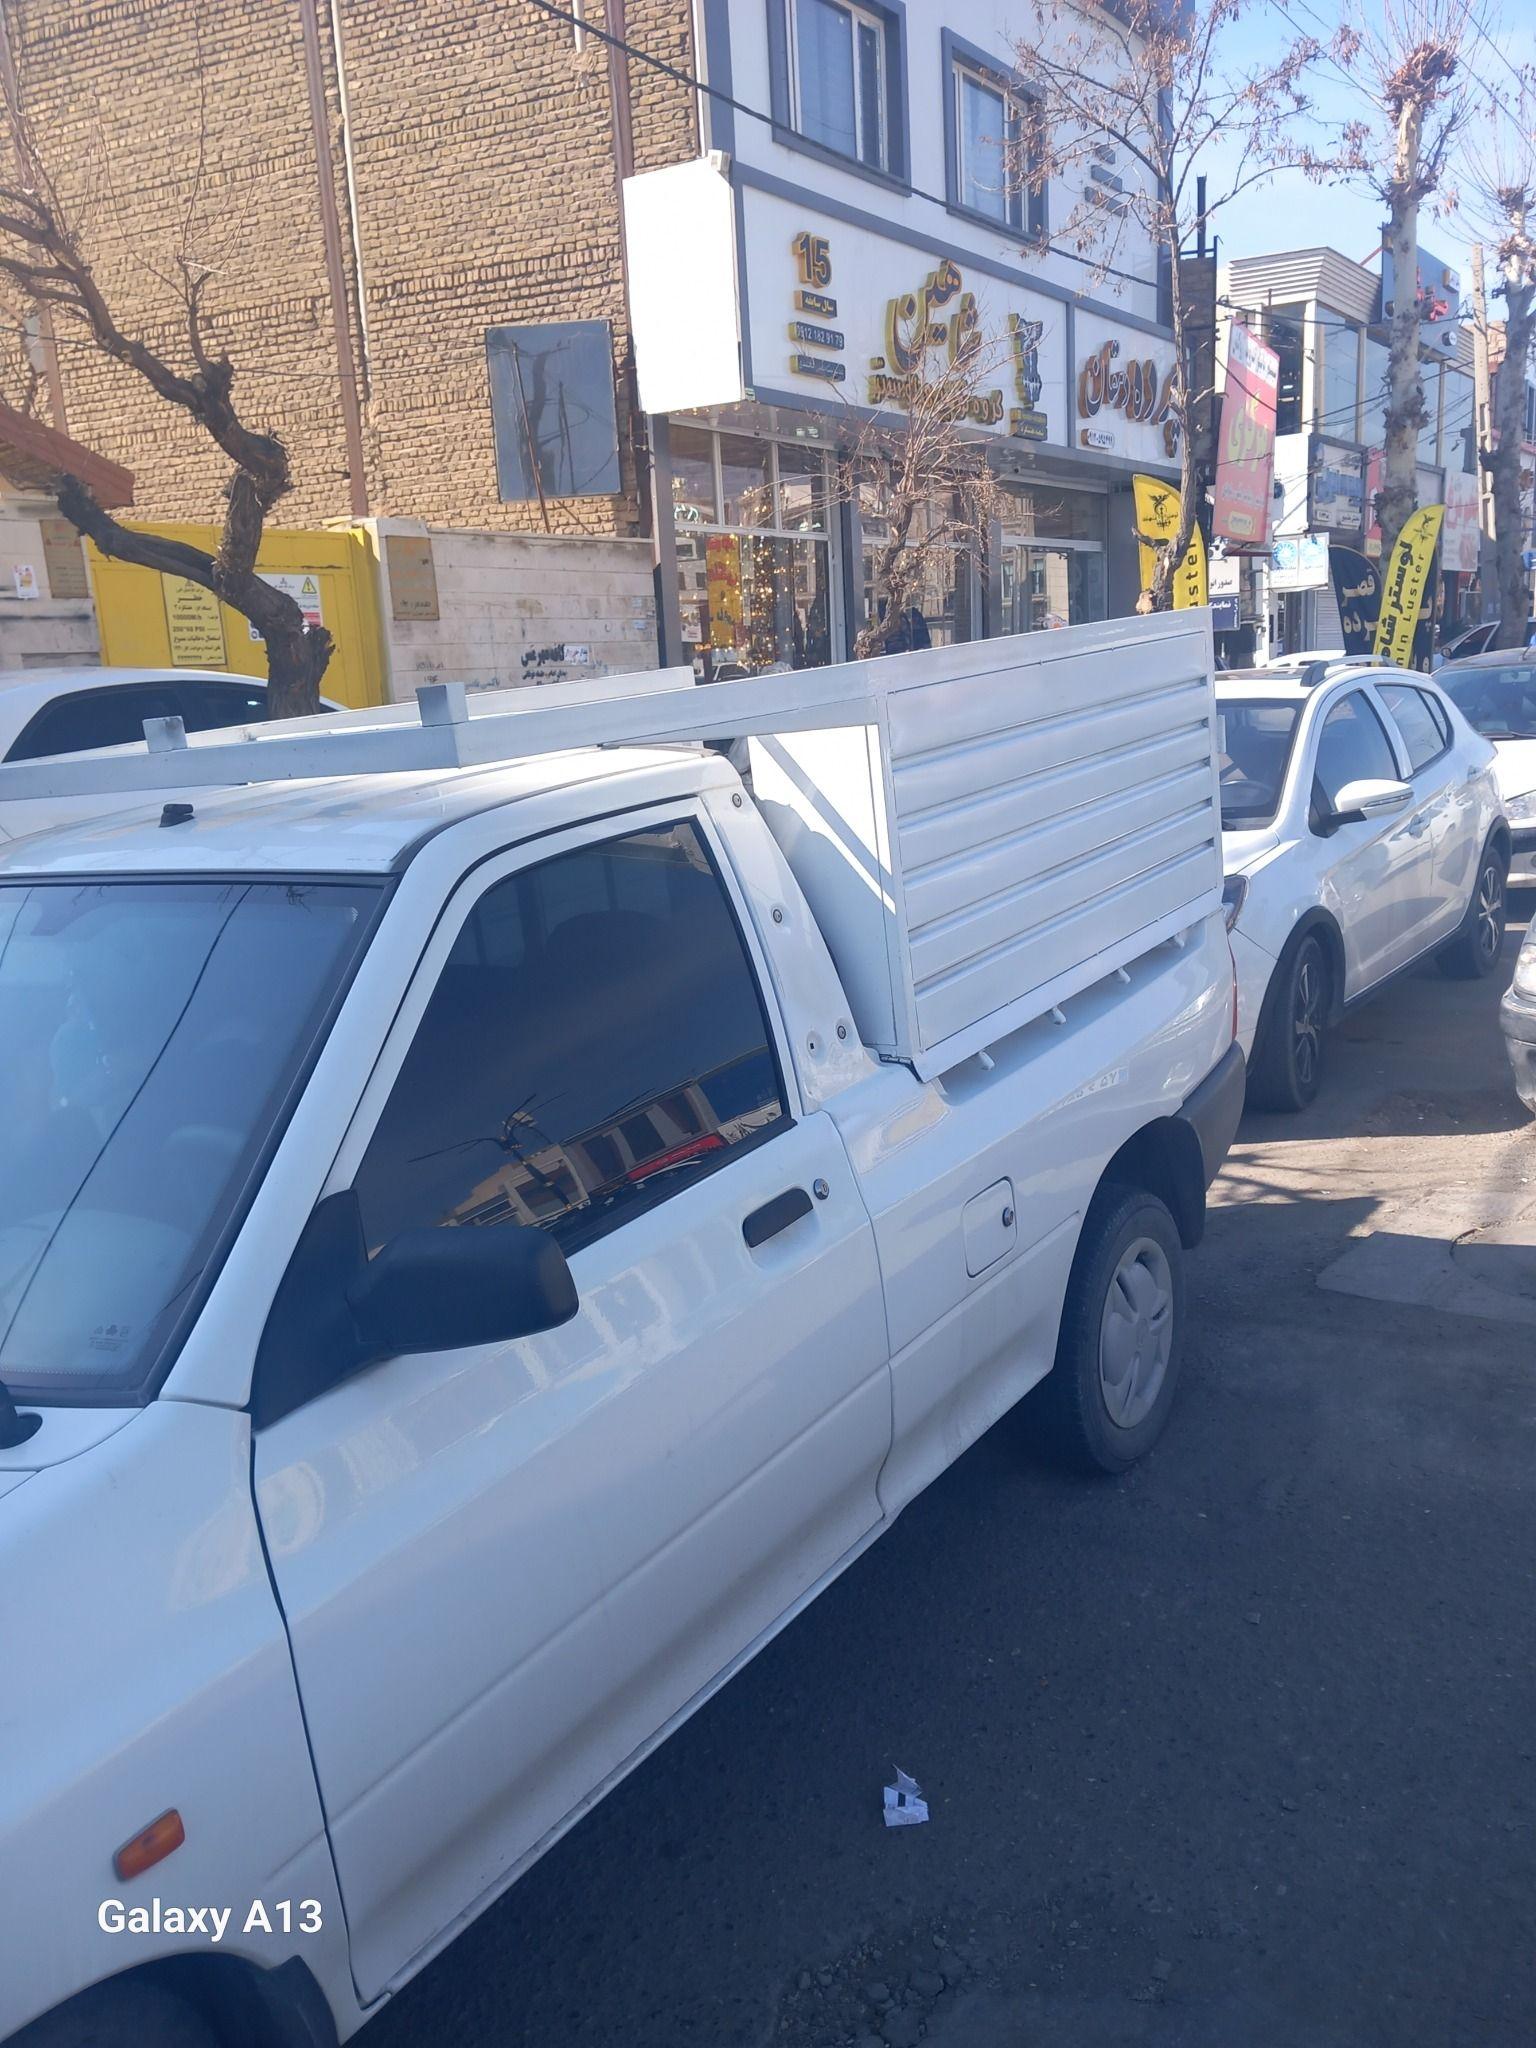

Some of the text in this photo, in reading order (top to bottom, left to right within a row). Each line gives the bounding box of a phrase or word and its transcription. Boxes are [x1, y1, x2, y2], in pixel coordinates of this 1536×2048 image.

[794, 231, 832, 288] 15
[1391, 541, 1414, 615] لوستر
[1403, 554, 1426, 623] Luster
